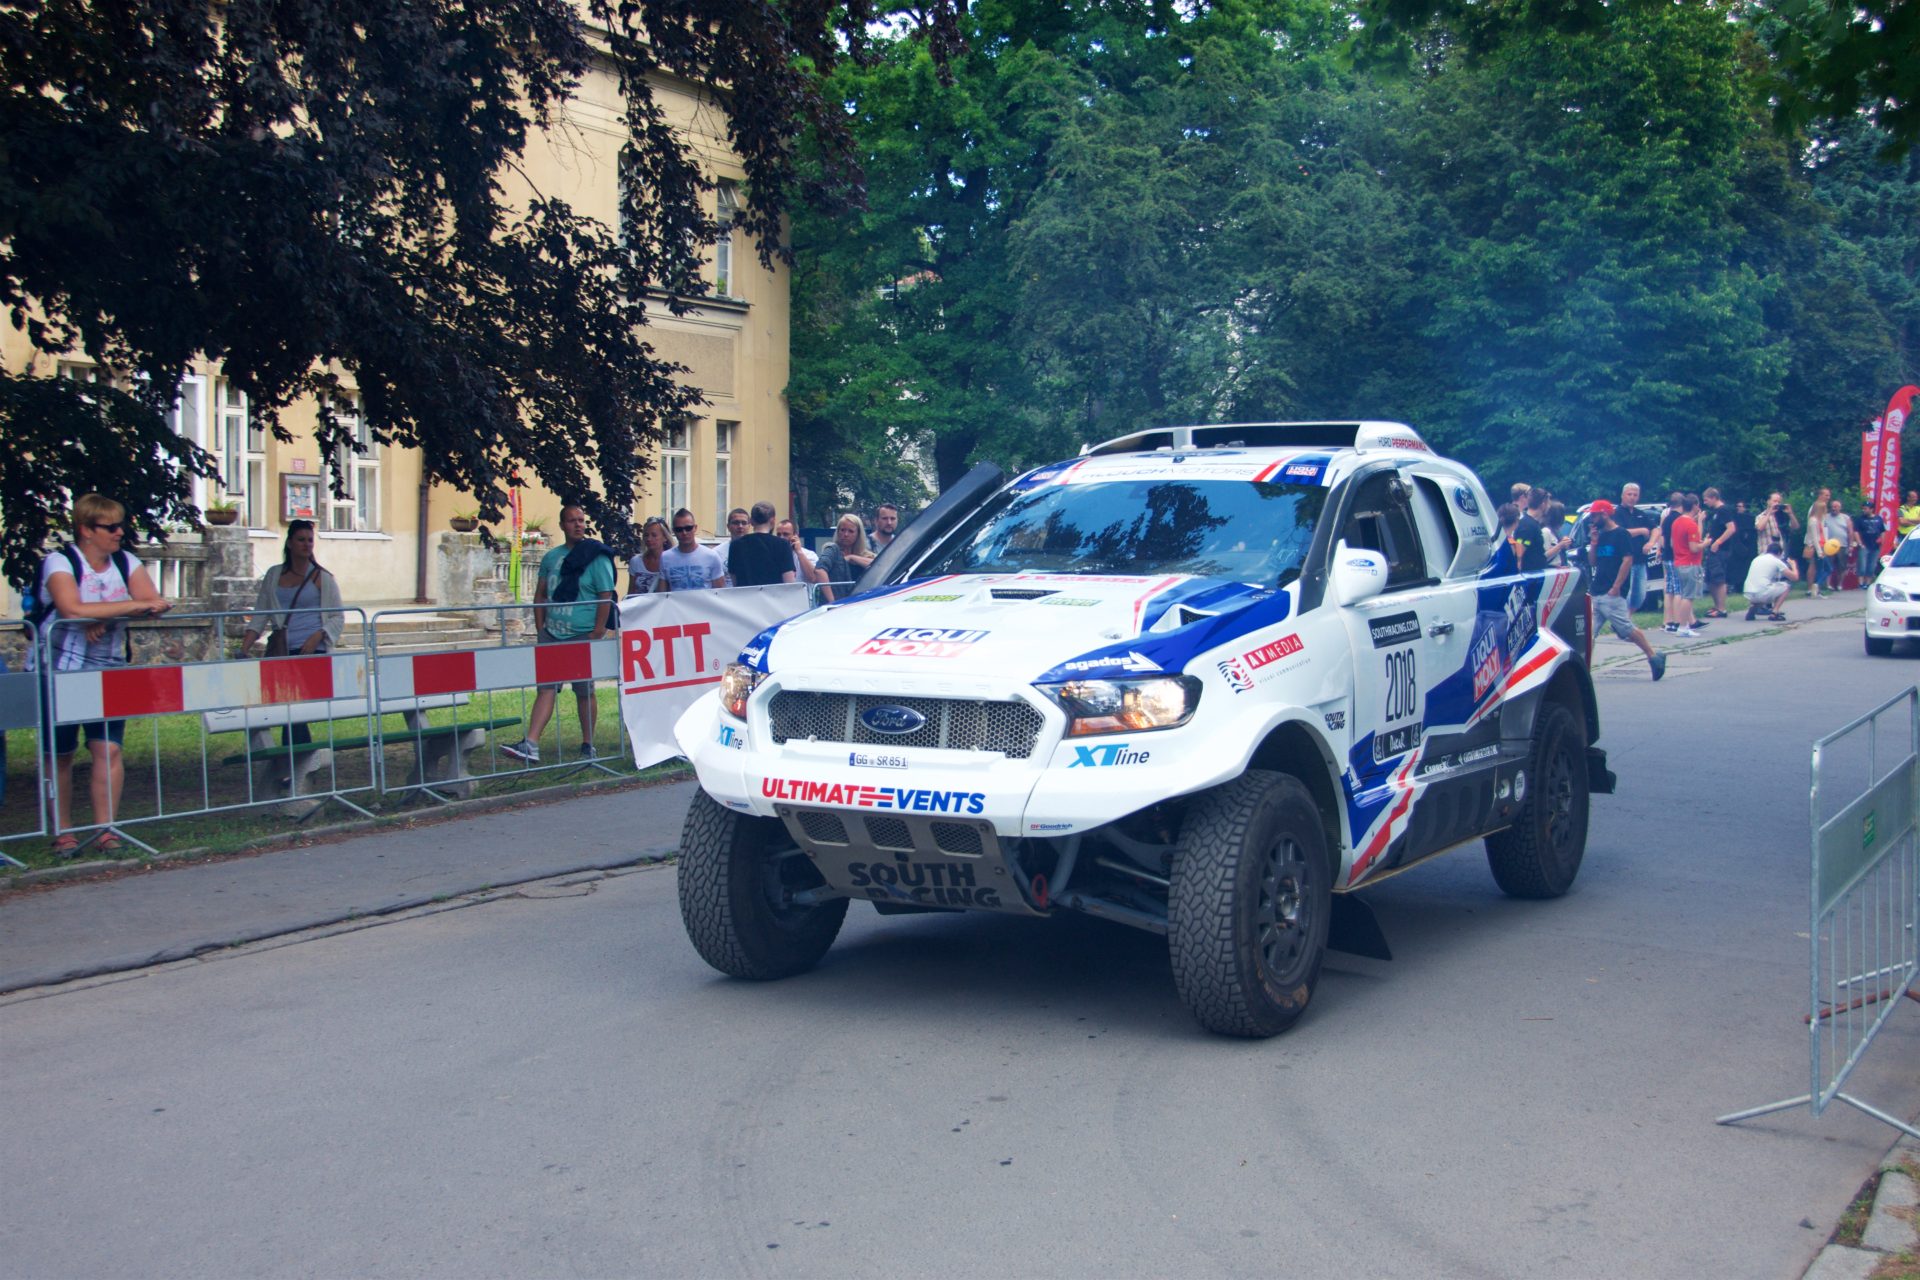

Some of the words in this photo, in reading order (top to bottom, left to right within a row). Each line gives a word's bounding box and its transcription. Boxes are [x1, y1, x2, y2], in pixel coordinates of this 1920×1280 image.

[876, 628, 986, 642] LIQUI
[1372, 620, 1418, 639] SOUTHRACING.COM
[622, 623, 711, 682] RTT
[861, 641, 969, 656] MOLY
[1473, 626, 1496, 673] LIQUI
[1065, 657, 1132, 671] agados
[1385, 648, 1416, 722] 2018
[1474, 654, 1499, 698] MOLY
[872, 710, 908, 728] Ford
[1325, 711, 1344, 722] SOUTH
[856, 755, 868, 765] GG
[1067, 744, 1150, 768] XTline
[848, 862, 976, 887] SOUTH
